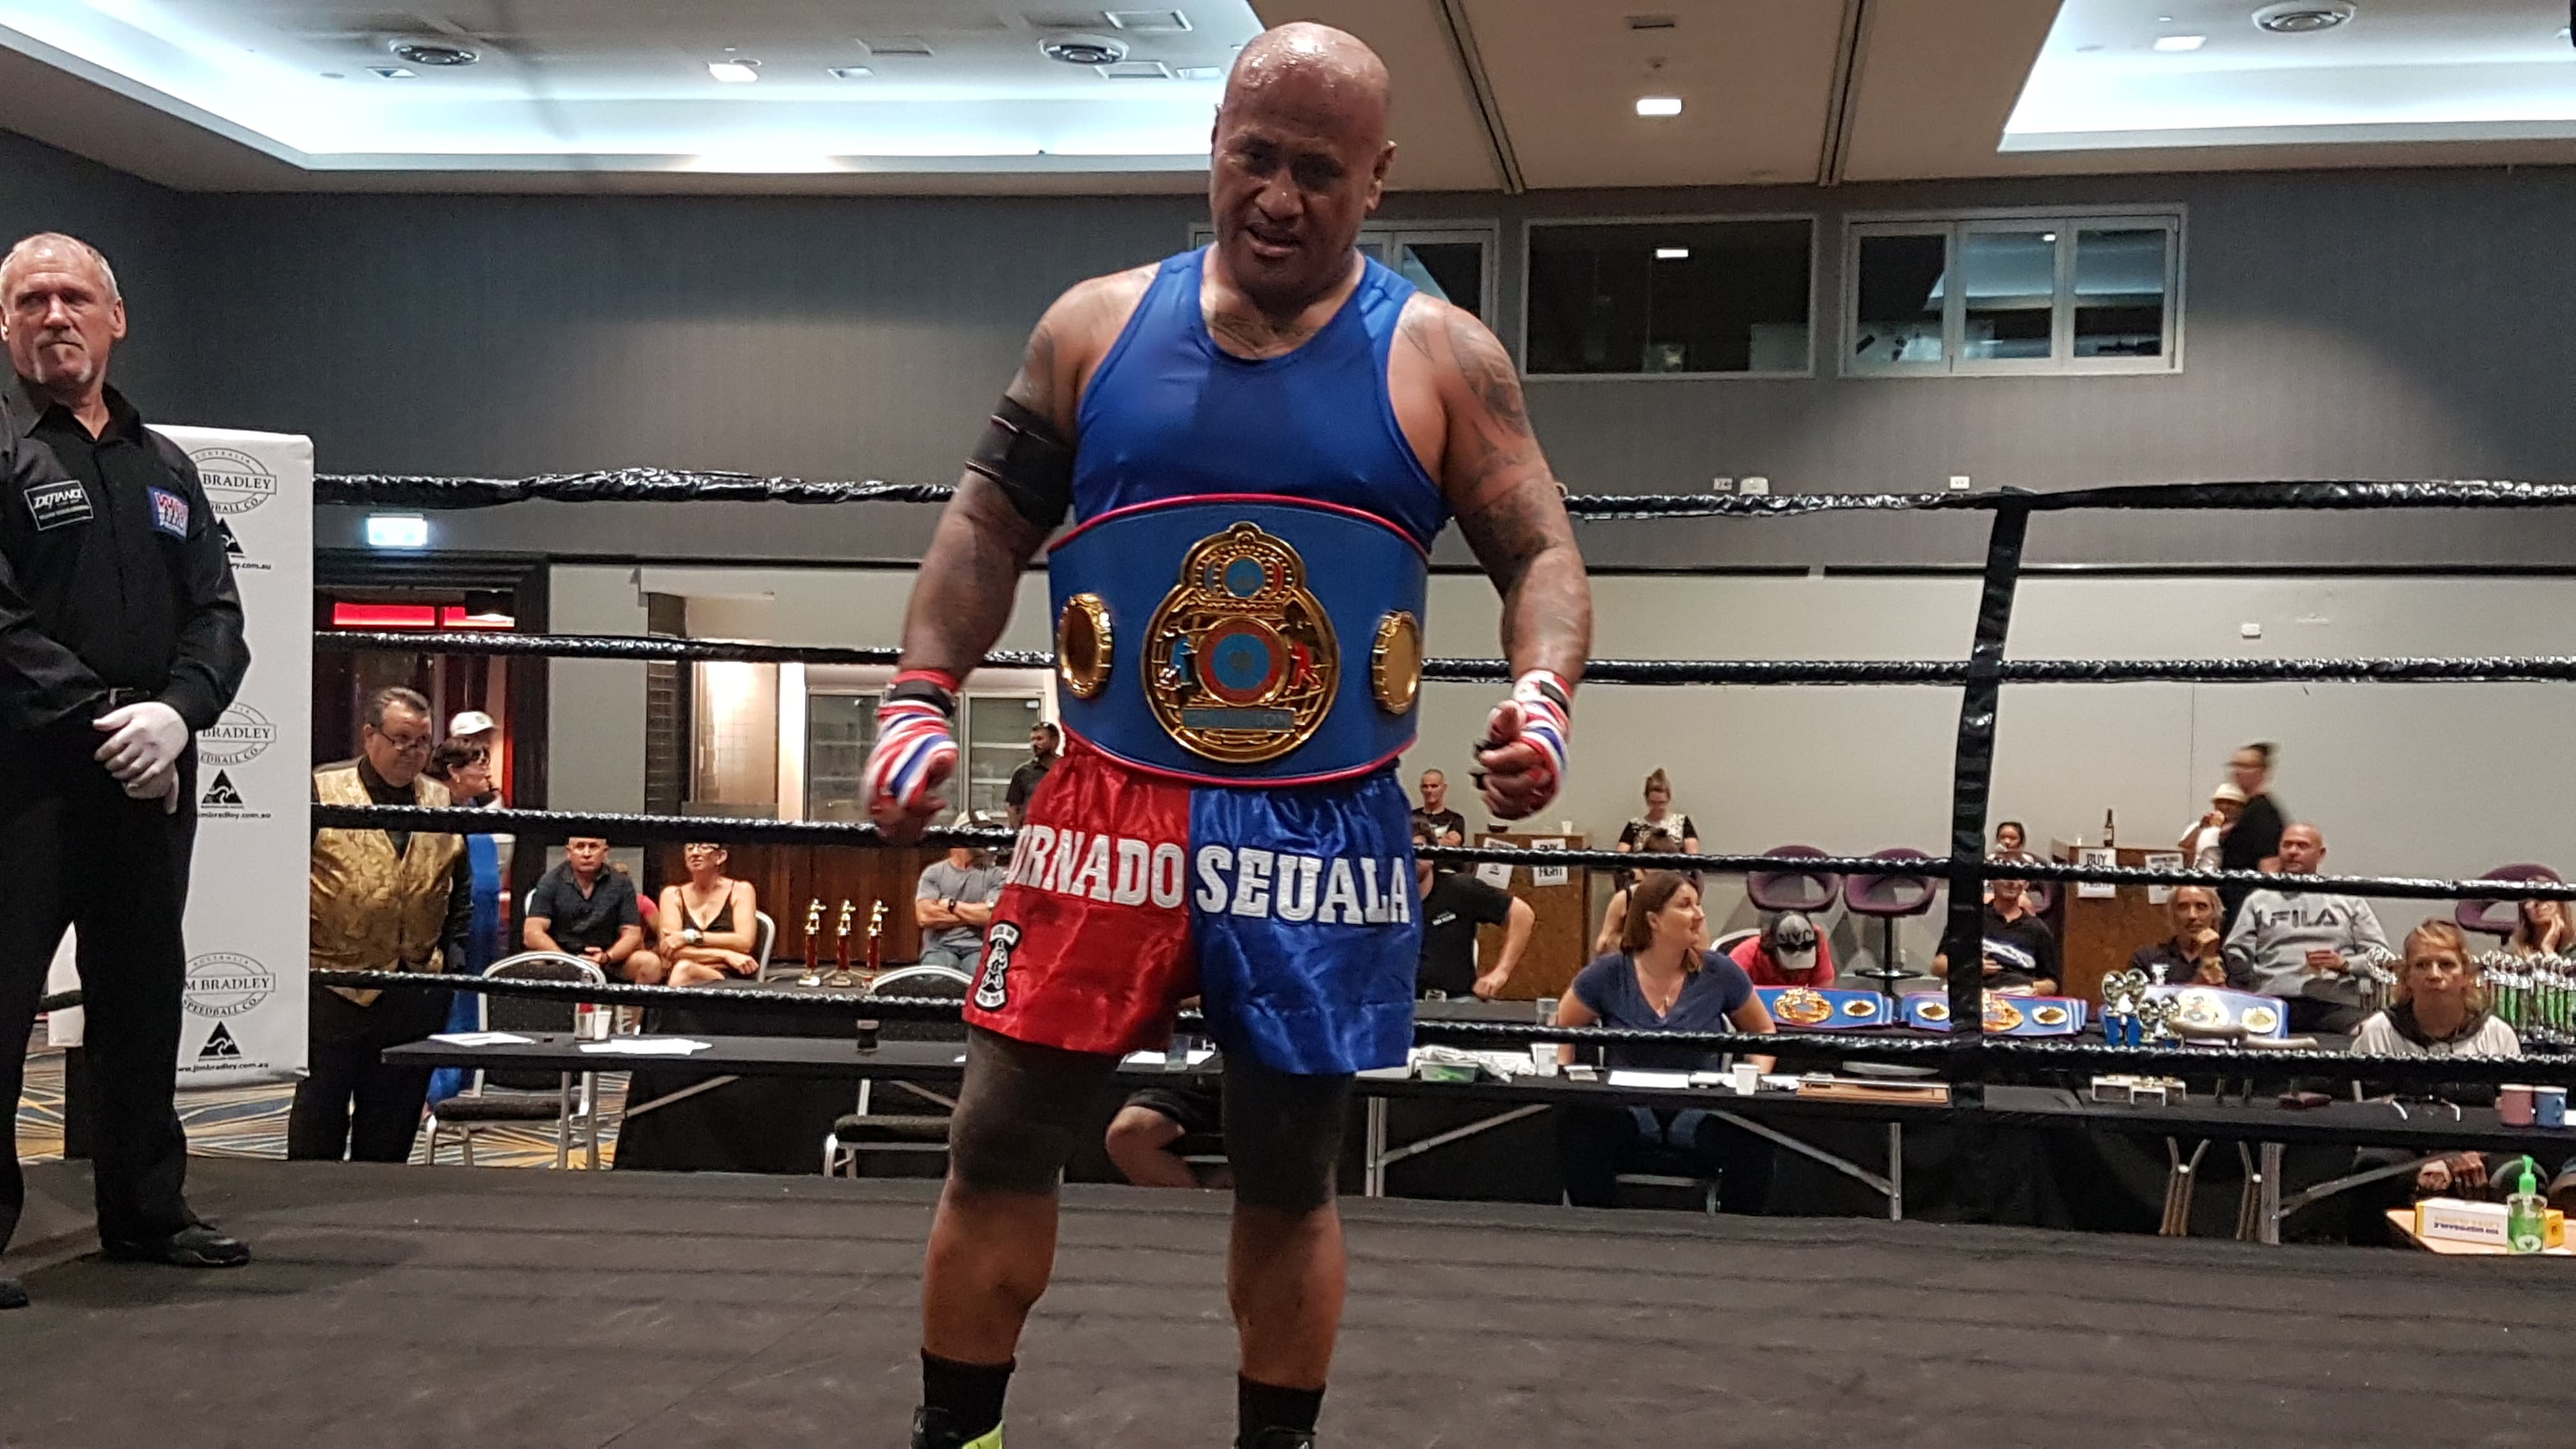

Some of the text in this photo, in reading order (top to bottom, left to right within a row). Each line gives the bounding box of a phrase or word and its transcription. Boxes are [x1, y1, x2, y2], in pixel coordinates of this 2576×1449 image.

[203, 473, 272, 490] BRADLEY
[203, 726, 270, 739] BRADLEY
[1196, 845, 1411, 924] SEUALA
[2271, 908, 2339, 928] FILA
[201, 977, 270, 991] BRADLEY
